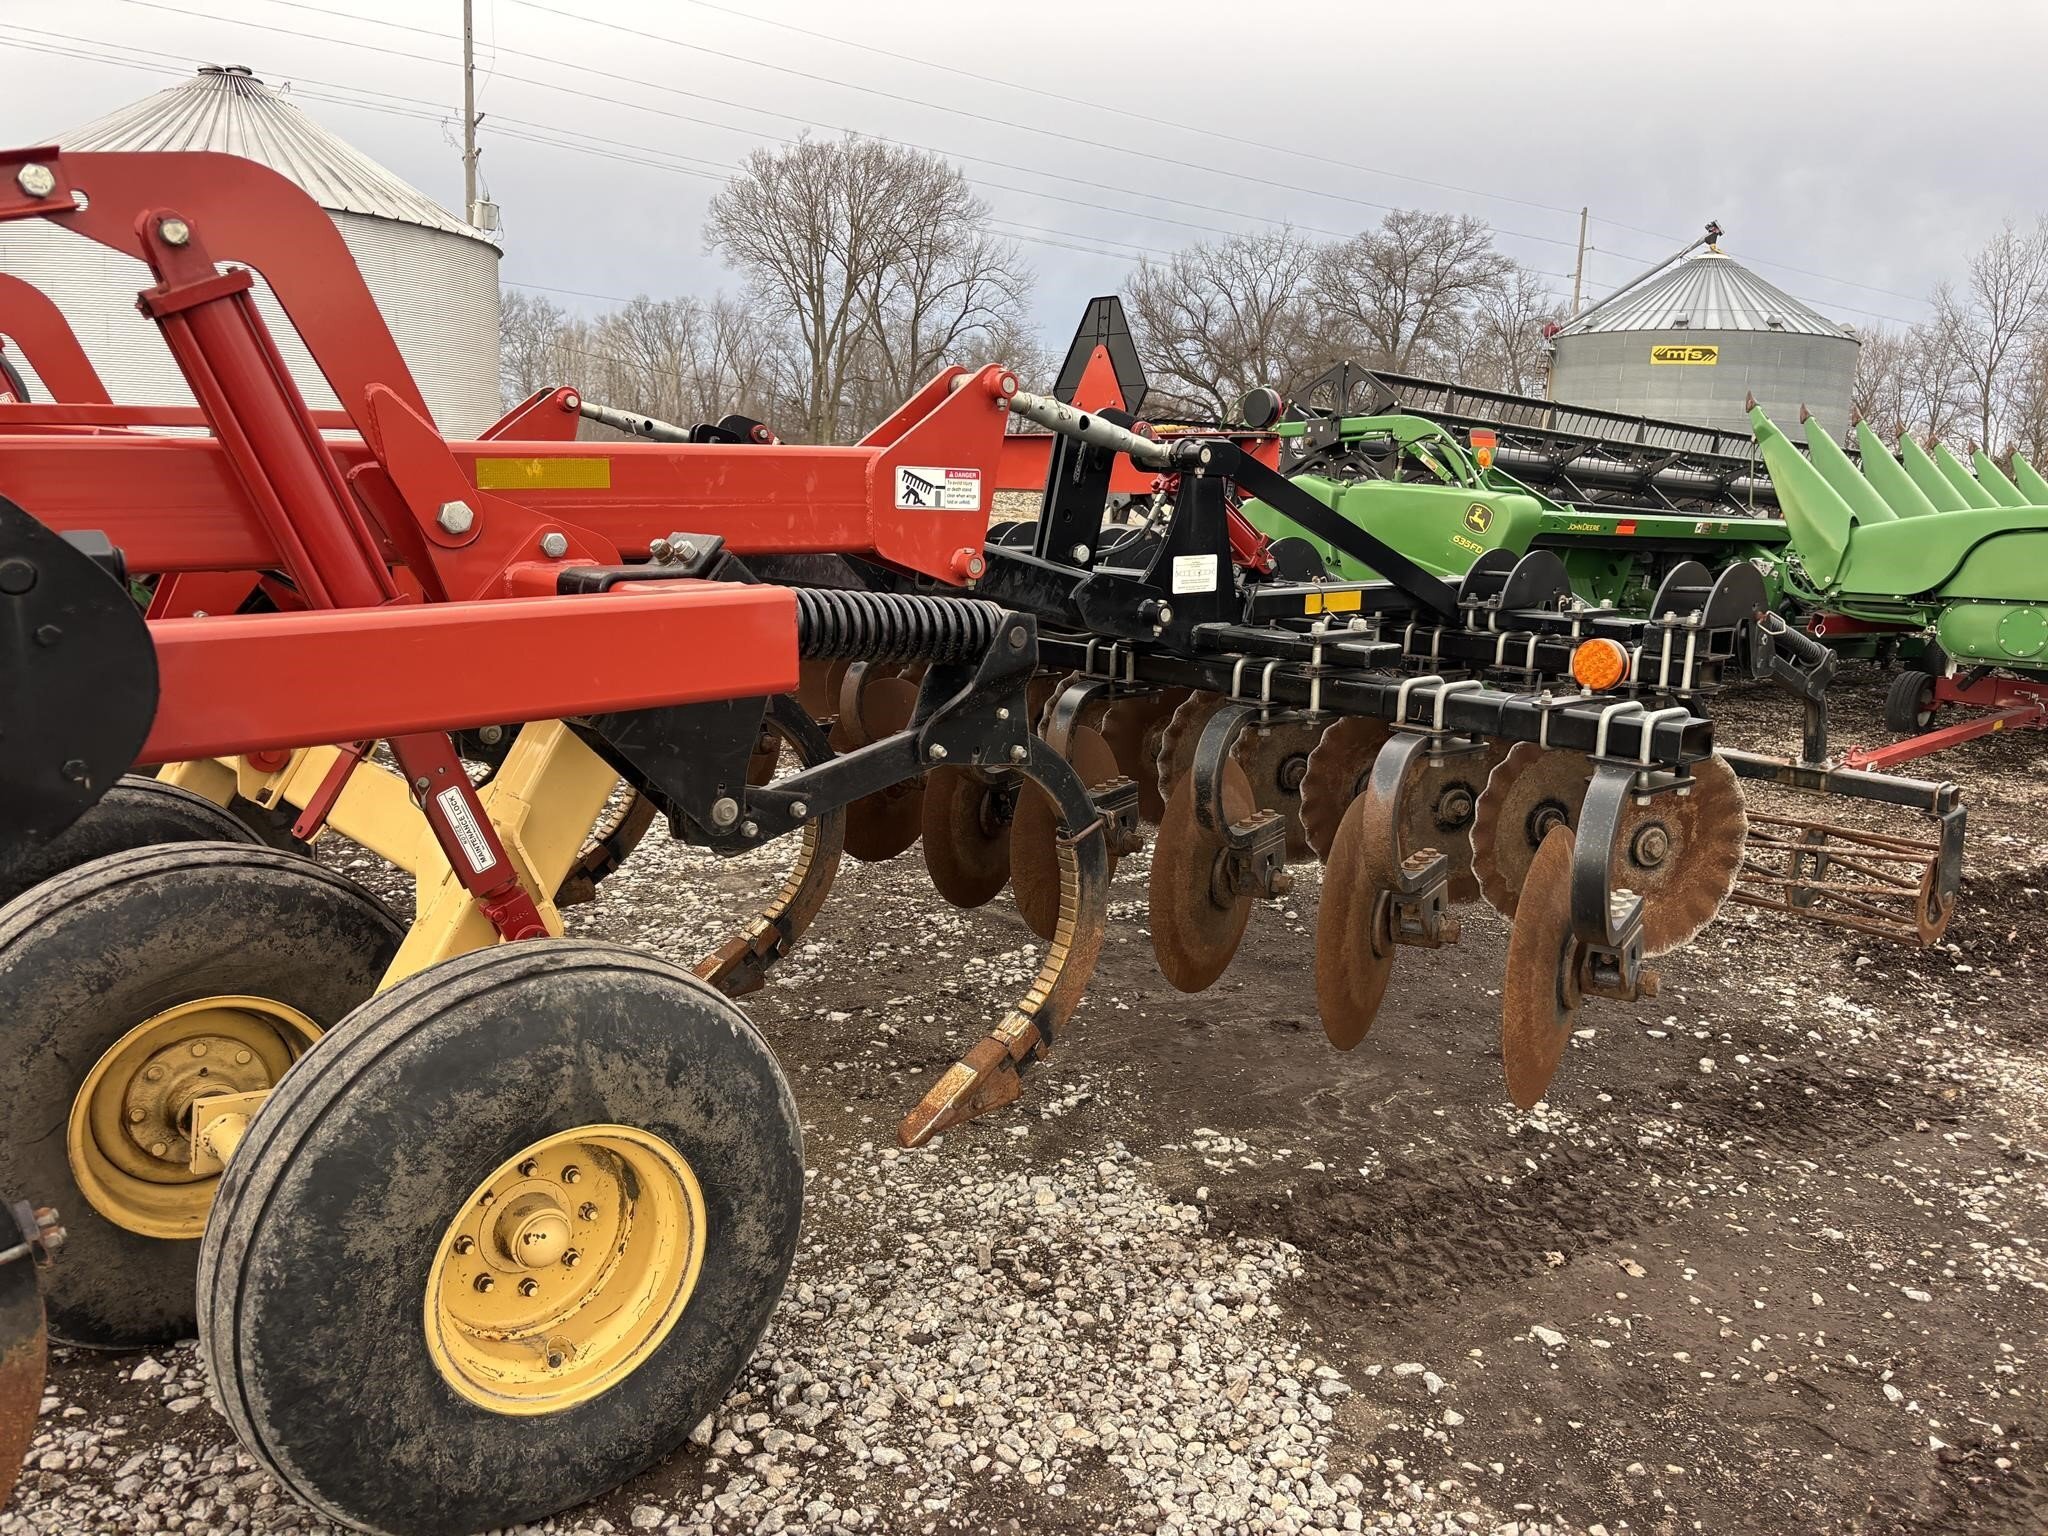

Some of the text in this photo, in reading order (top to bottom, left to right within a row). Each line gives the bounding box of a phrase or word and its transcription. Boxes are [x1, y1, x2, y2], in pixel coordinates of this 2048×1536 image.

[1666, 349, 1703, 361] mfs
[1567, 522, 1601, 531] JOHN DEERE
[1452, 534, 1483, 554] 635FD
[448, 795, 463, 816] LOCK
[455, 825, 468, 845] NOTICE
[459, 815, 487, 863] MAINTENANCE
